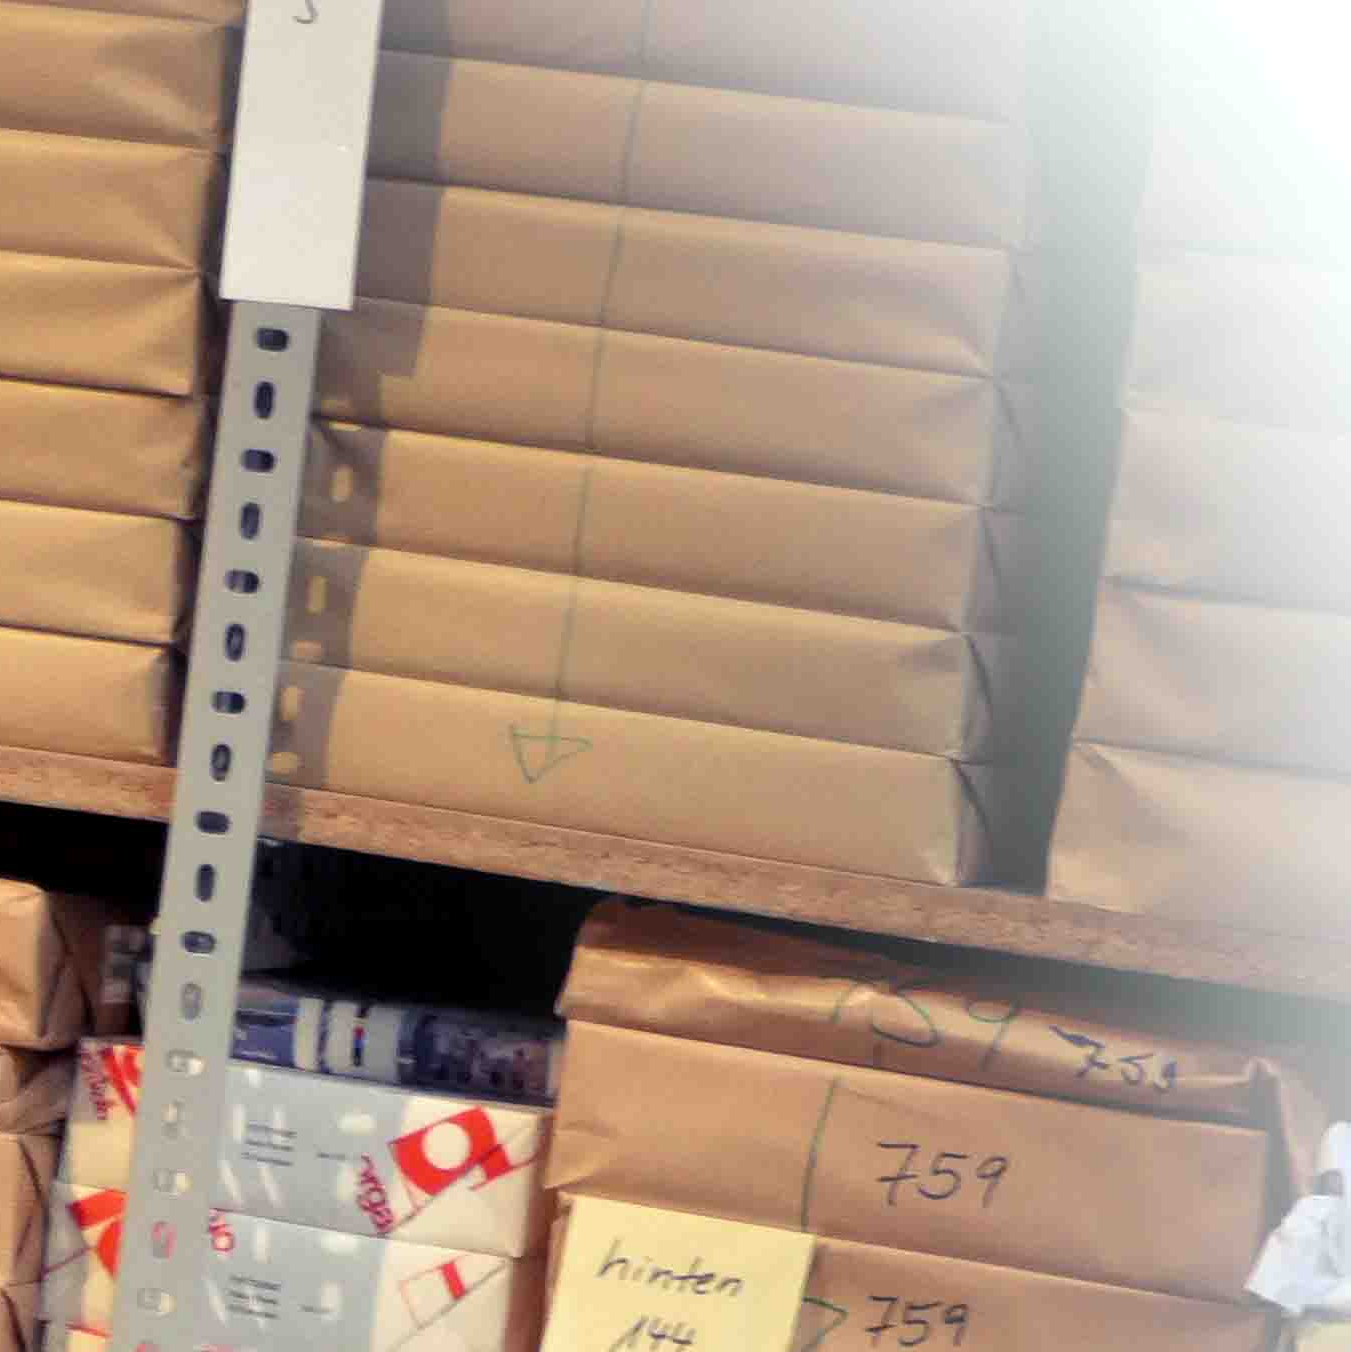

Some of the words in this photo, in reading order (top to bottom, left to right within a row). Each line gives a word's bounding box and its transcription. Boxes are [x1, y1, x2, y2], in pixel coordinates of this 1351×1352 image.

[875, 1140, 1009, 1208] 759
[596, 1236, 743, 1298] hinten
[864, 1295, 969, 1347] 759
